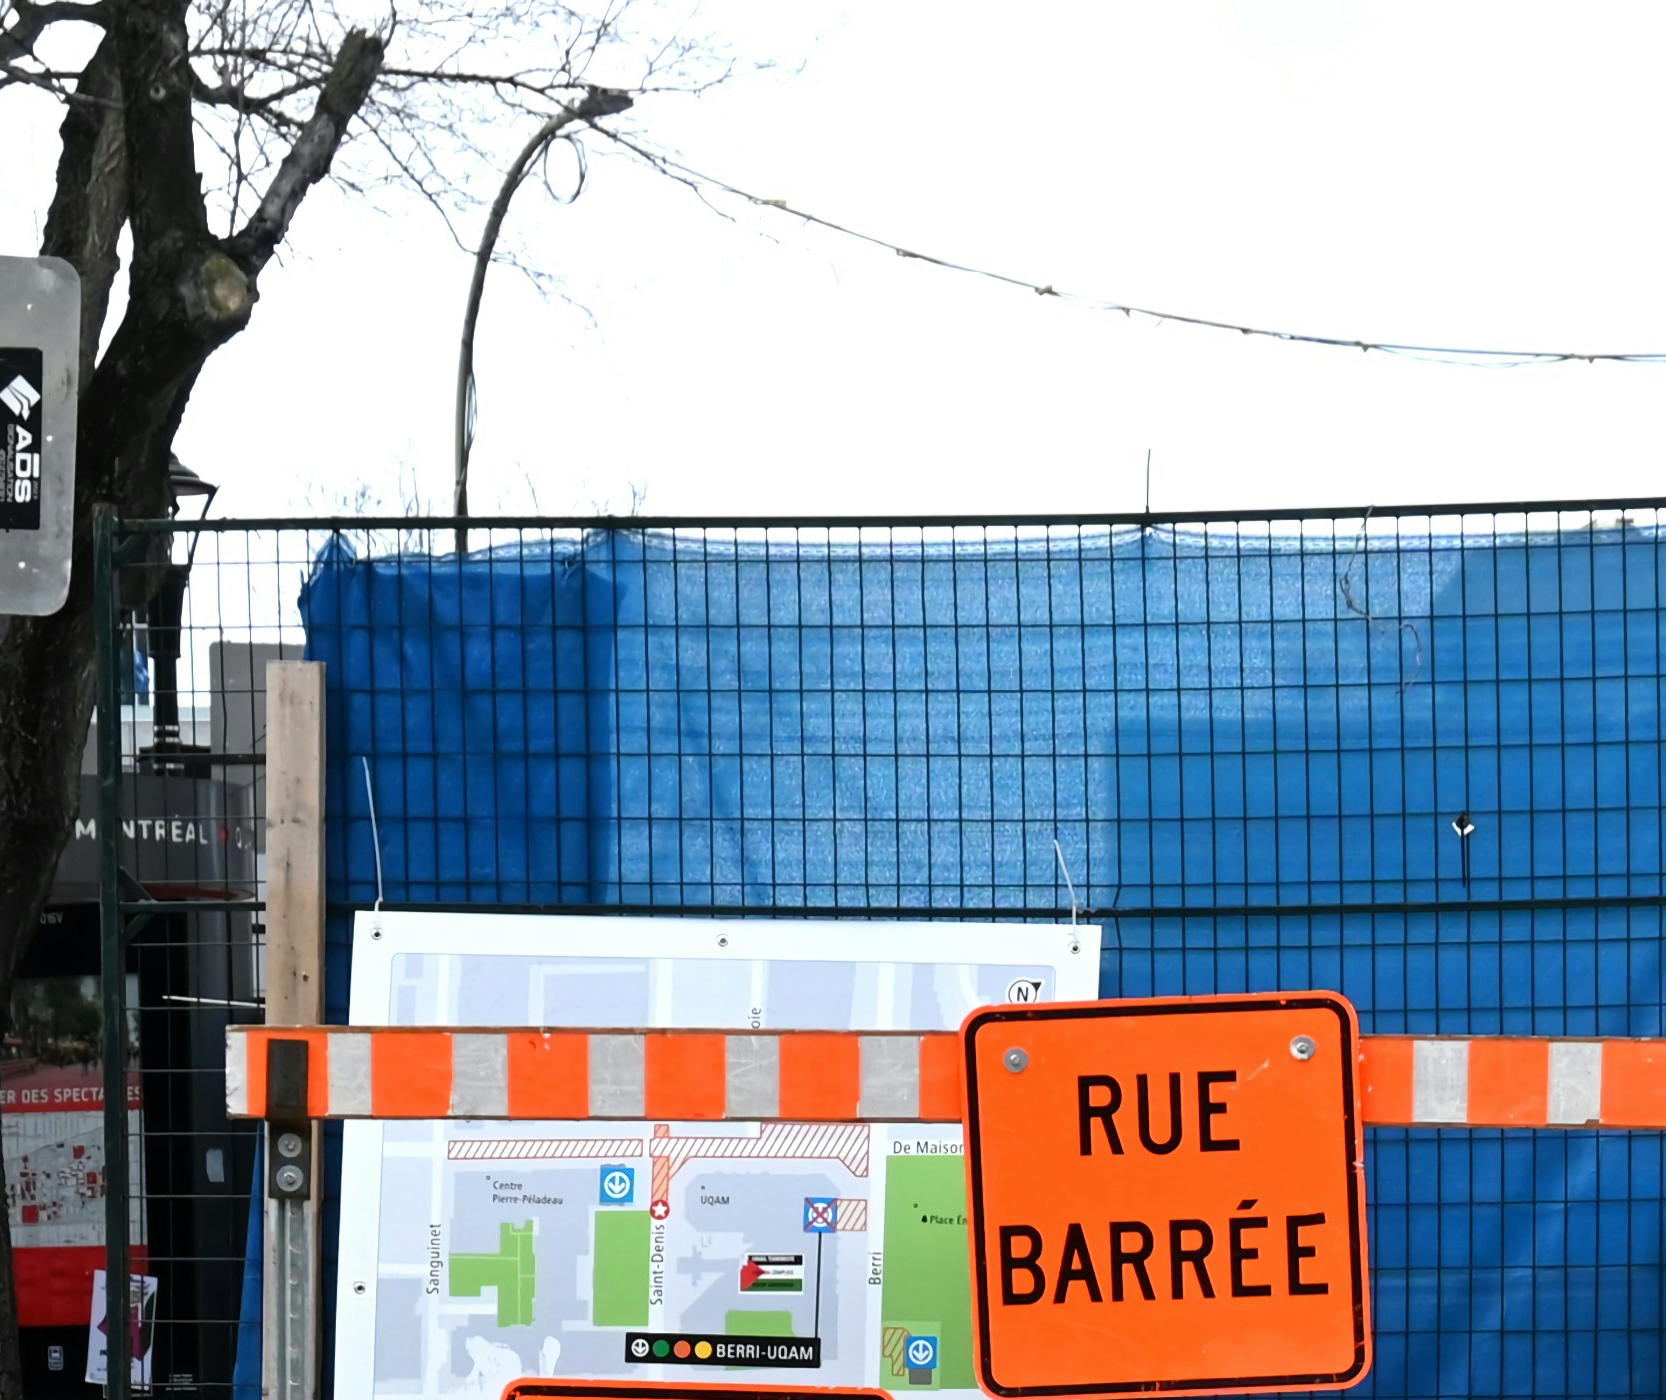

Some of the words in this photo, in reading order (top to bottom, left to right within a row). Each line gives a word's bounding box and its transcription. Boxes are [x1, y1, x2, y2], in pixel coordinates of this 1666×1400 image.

[15, 424, 32, 503] ADS
[75, 814, 209, 845] MNTRÉAL
[1016, 986, 1029, 1003] N
[0, 1088, 16, 1105] ER
[21, 1088, 49, 1104] DES
[1076, 1070, 1243, 1157] RUE
[893, 1140, 911, 1154] De
[492, 1180, 523, 1191] Centre
[492, 1193, 564, 1205] Pierre-Péladeau
[700, 1195, 730, 1207] UQAM
[929, 1214, 954, 1225] Place
[426, 1223, 444, 1295] Sanguinet
[998, 1199, 1331, 1307] BARRÉE
[649, 1224, 665, 1306] Saint-Denis
[868, 1251, 882, 1286] Berri
[716, 1343, 814, 1361] BERRI-UQAM
